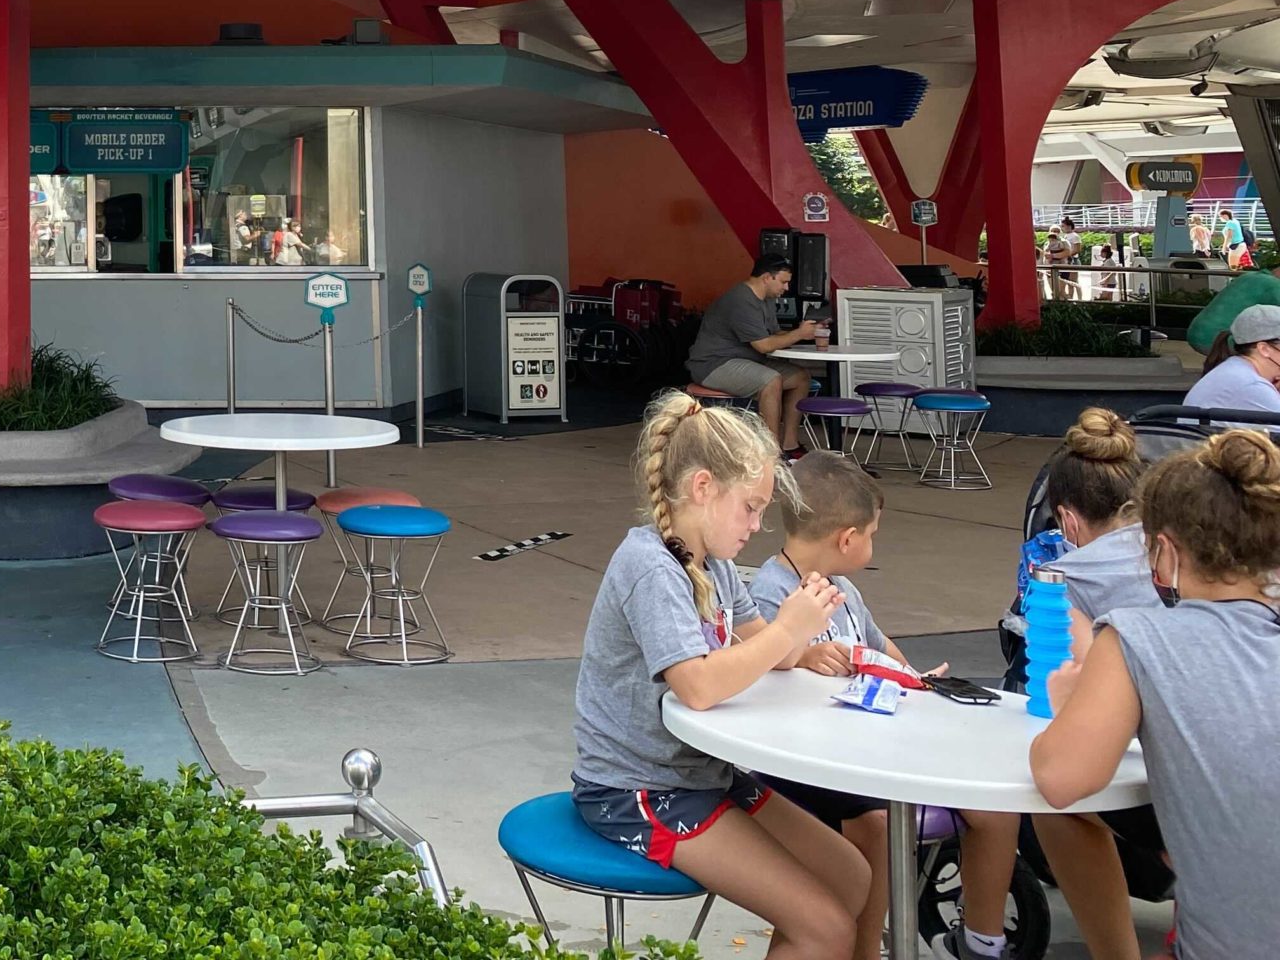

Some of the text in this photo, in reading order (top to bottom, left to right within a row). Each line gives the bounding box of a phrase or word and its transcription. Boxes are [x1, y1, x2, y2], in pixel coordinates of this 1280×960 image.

[821, 100, 874, 119] STATION
[84, 133, 166, 145] MOBILE ORDER
[97, 148, 153, 160] PICK-UP 1
[311, 283, 343, 291] ENTER
